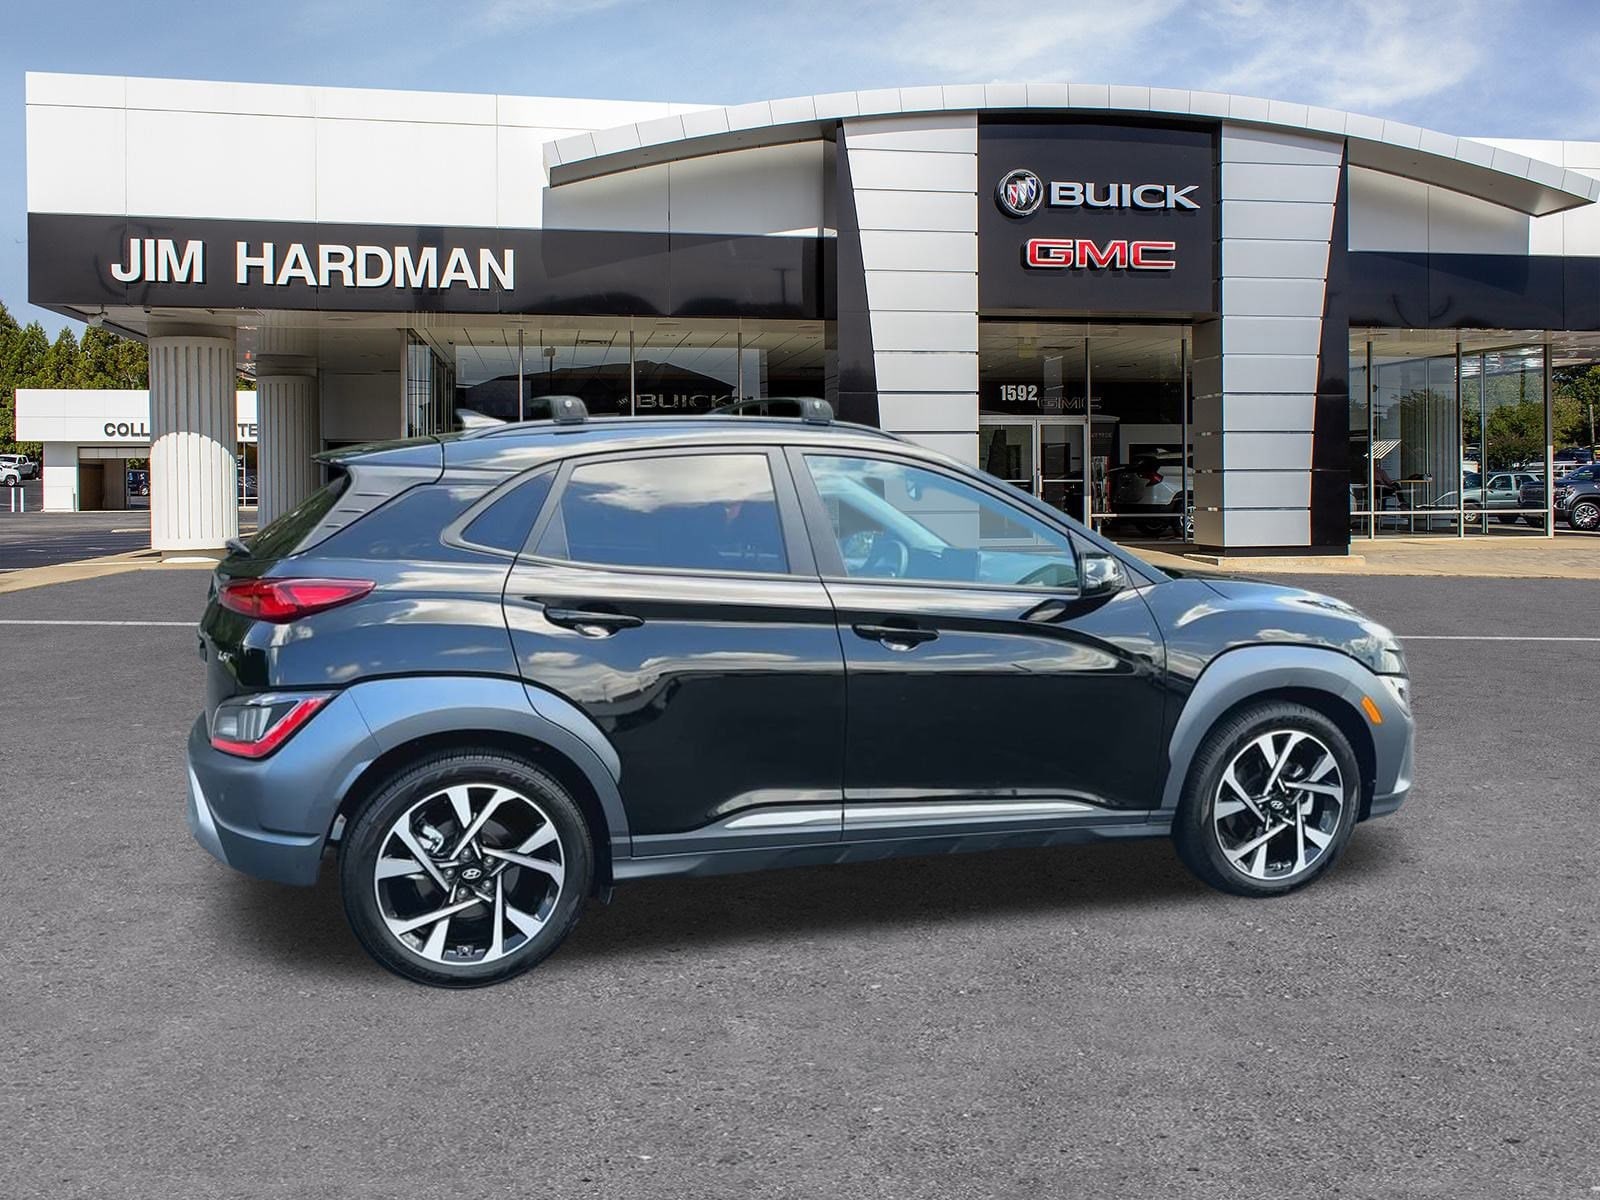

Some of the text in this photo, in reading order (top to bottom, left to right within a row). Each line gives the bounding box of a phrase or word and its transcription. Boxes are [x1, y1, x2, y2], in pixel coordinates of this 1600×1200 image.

[1050, 181, 1200, 209] BUICK
[111, 238, 515, 290] JIM HARDMAN
[1026, 238, 1176, 270] GMC
[635, 393, 731, 408] BUICK
[1000, 385, 1038, 401] 1592
[1036, 396, 1102, 409] GMC
